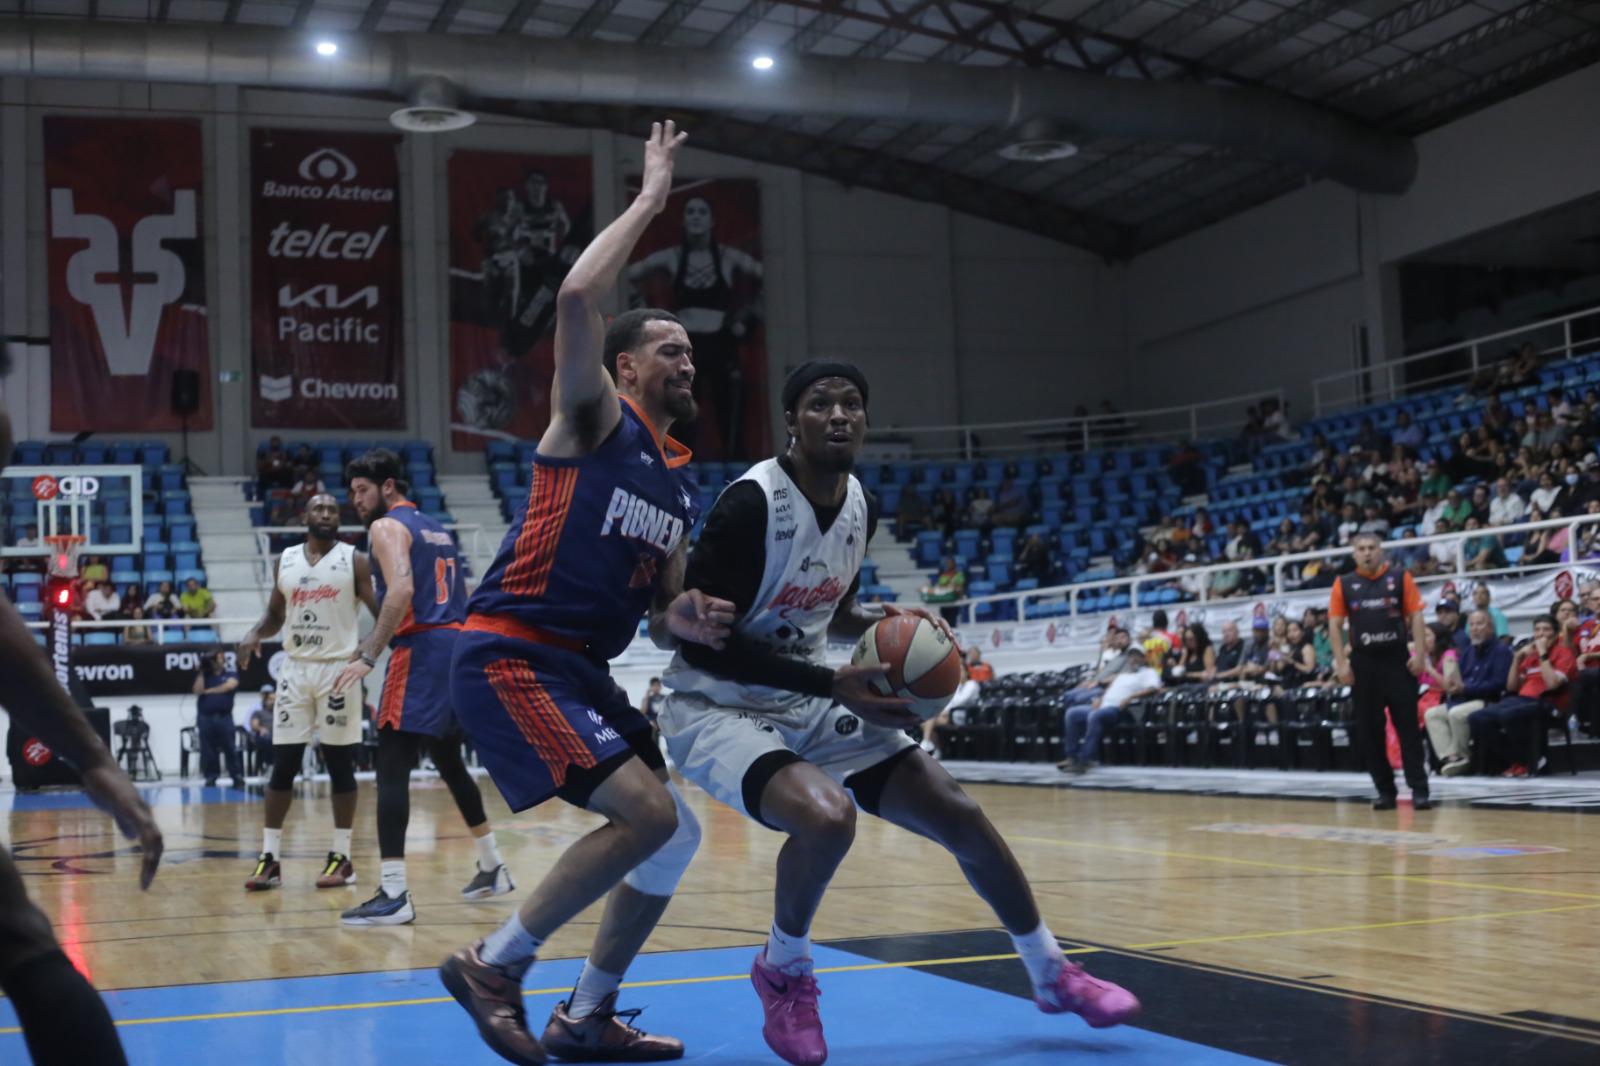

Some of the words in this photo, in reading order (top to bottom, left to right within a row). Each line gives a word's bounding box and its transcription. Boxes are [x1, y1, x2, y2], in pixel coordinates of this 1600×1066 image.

[262, 180, 324, 199] Banco
[326, 184, 394, 202] Azteca
[267, 221, 388, 260] telcel
[278, 316, 380, 343] Pacific
[300, 377, 398, 399] Chevron
[75, 664, 134, 681] evron
